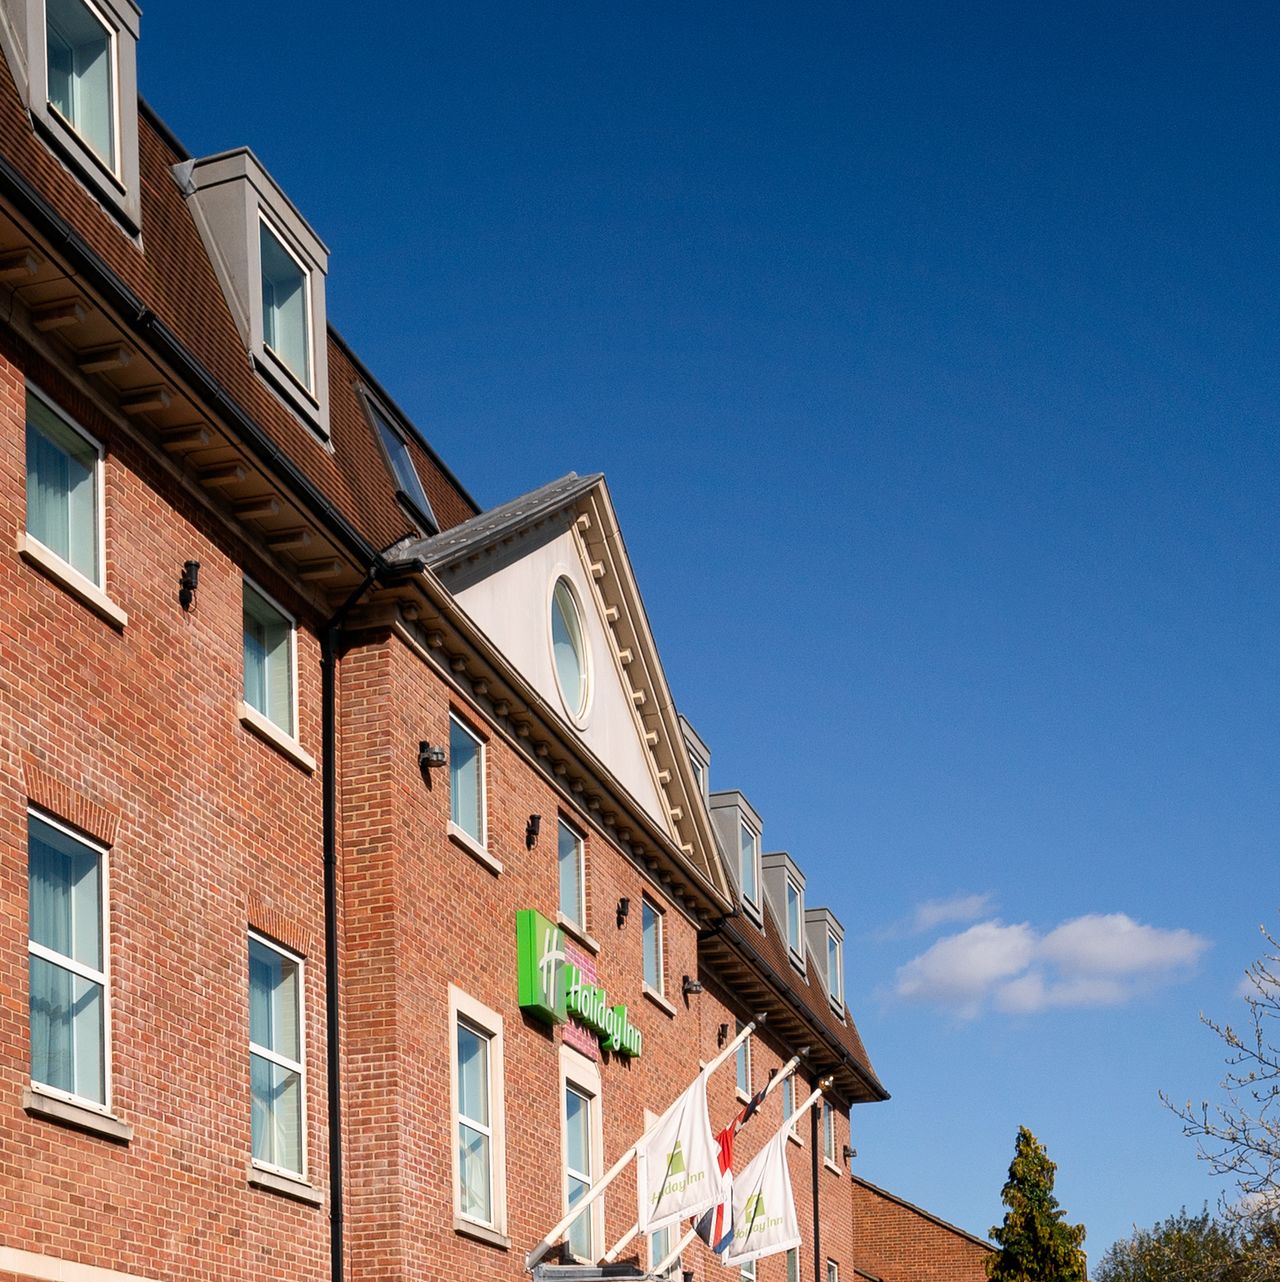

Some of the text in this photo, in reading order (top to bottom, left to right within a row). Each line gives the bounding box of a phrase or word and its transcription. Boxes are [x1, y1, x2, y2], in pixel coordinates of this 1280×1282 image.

[569, 965, 642, 1057] Holiday Inn
[687, 1171, 704, 1186] Inn
[767, 1216, 783, 1228] Inn
